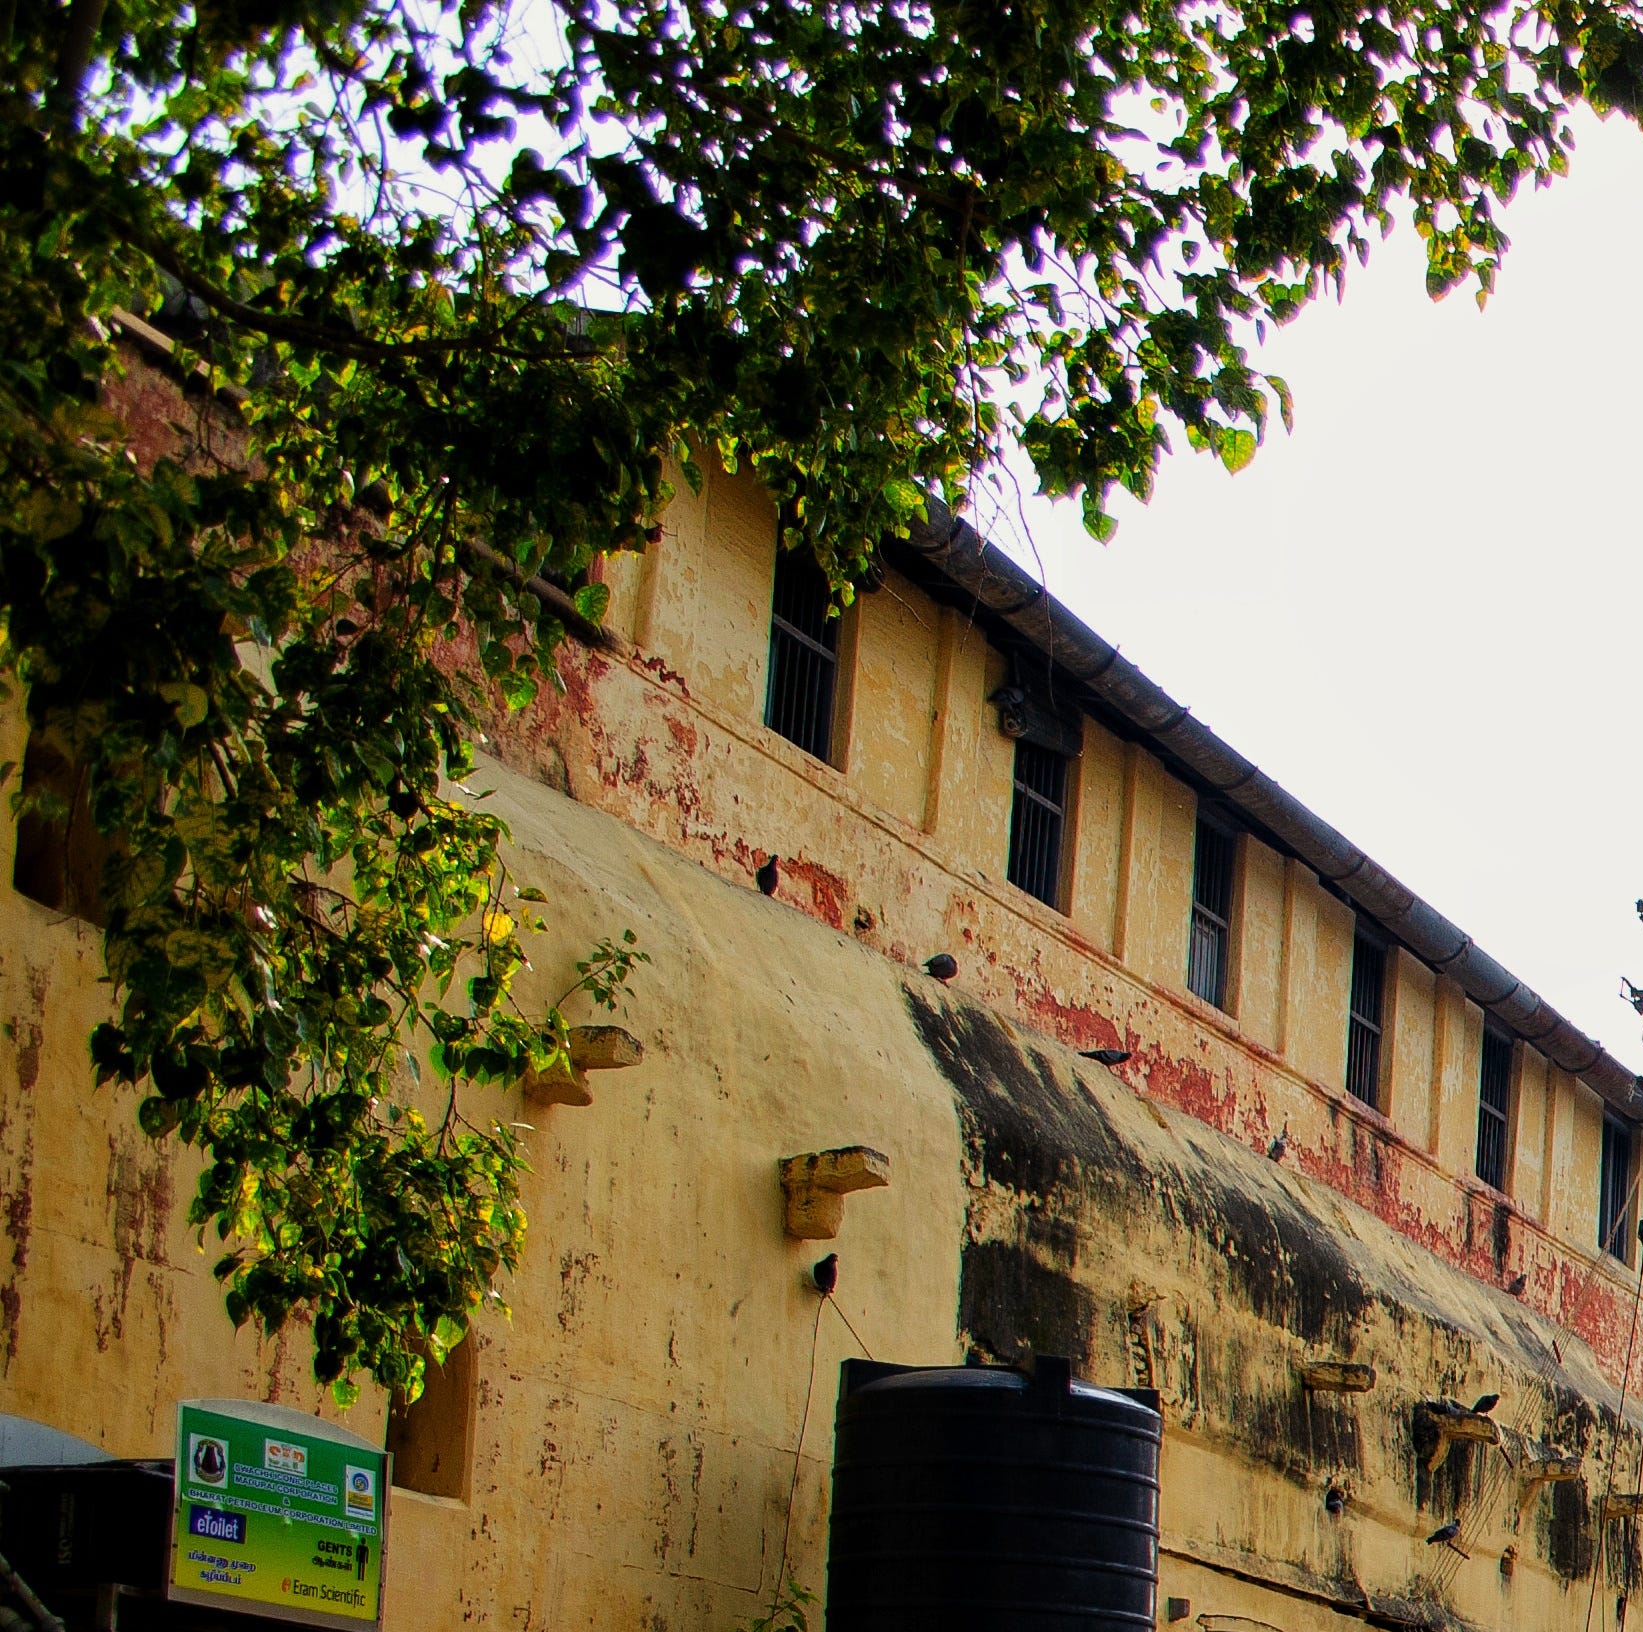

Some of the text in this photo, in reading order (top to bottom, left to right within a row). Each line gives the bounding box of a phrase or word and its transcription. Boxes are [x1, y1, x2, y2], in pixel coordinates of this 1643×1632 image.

[234, 1474, 338, 1505] MADURAI CORPORATION
[188, 1488, 225, 1503] BHARAT
[226, 1496, 282, 1516] PETROLEUM
[283, 1508, 343, 1529] CORPORATION
[345, 1520, 377, 1536] LIMITED
[197, 1510, 238, 1540] eToilet
[318, 1540, 352, 1556] GENTS
[293, 1579, 366, 1608] Eram Scientific
